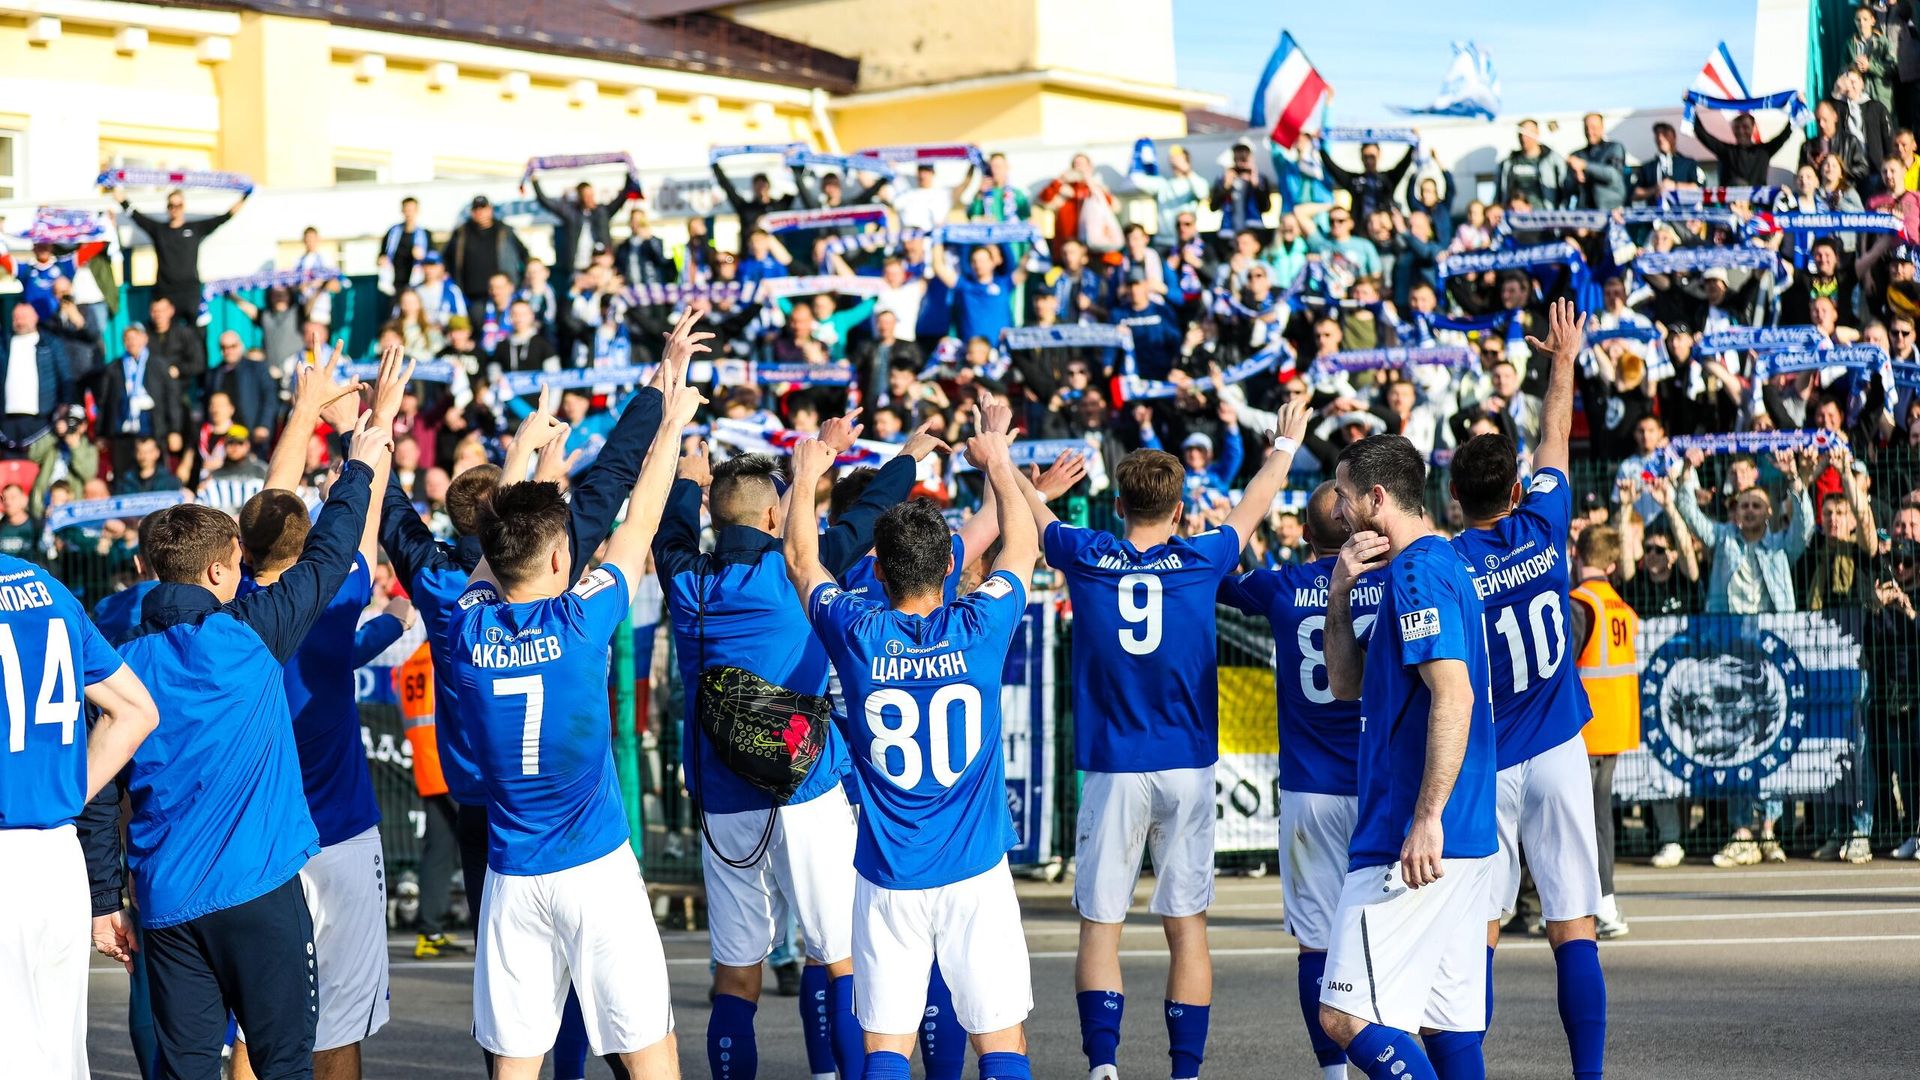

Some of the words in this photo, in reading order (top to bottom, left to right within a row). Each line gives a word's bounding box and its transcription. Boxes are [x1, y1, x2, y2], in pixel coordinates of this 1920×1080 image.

[0, 580, 53, 611] ПАЕВ
[1294, 581, 1385, 607] МАСРНОЙ
[1474, 542, 1559, 599] ЕЙЧИНОВИЧ
[1118, 573, 1163, 655] 9
[1495, 590, 1566, 694] 10
[1611, 617, 1627, 647] 91
[472, 635, 562, 669] АКБАШЕВ
[871, 650, 968, 683] ЦАРУКЯН
[1297, 614, 1377, 705] 8
[0, 618, 80, 753] 14
[493, 674, 544, 776] 7
[864, 683, 982, 791] 80
[1327, 980, 1353, 993] JAKO
